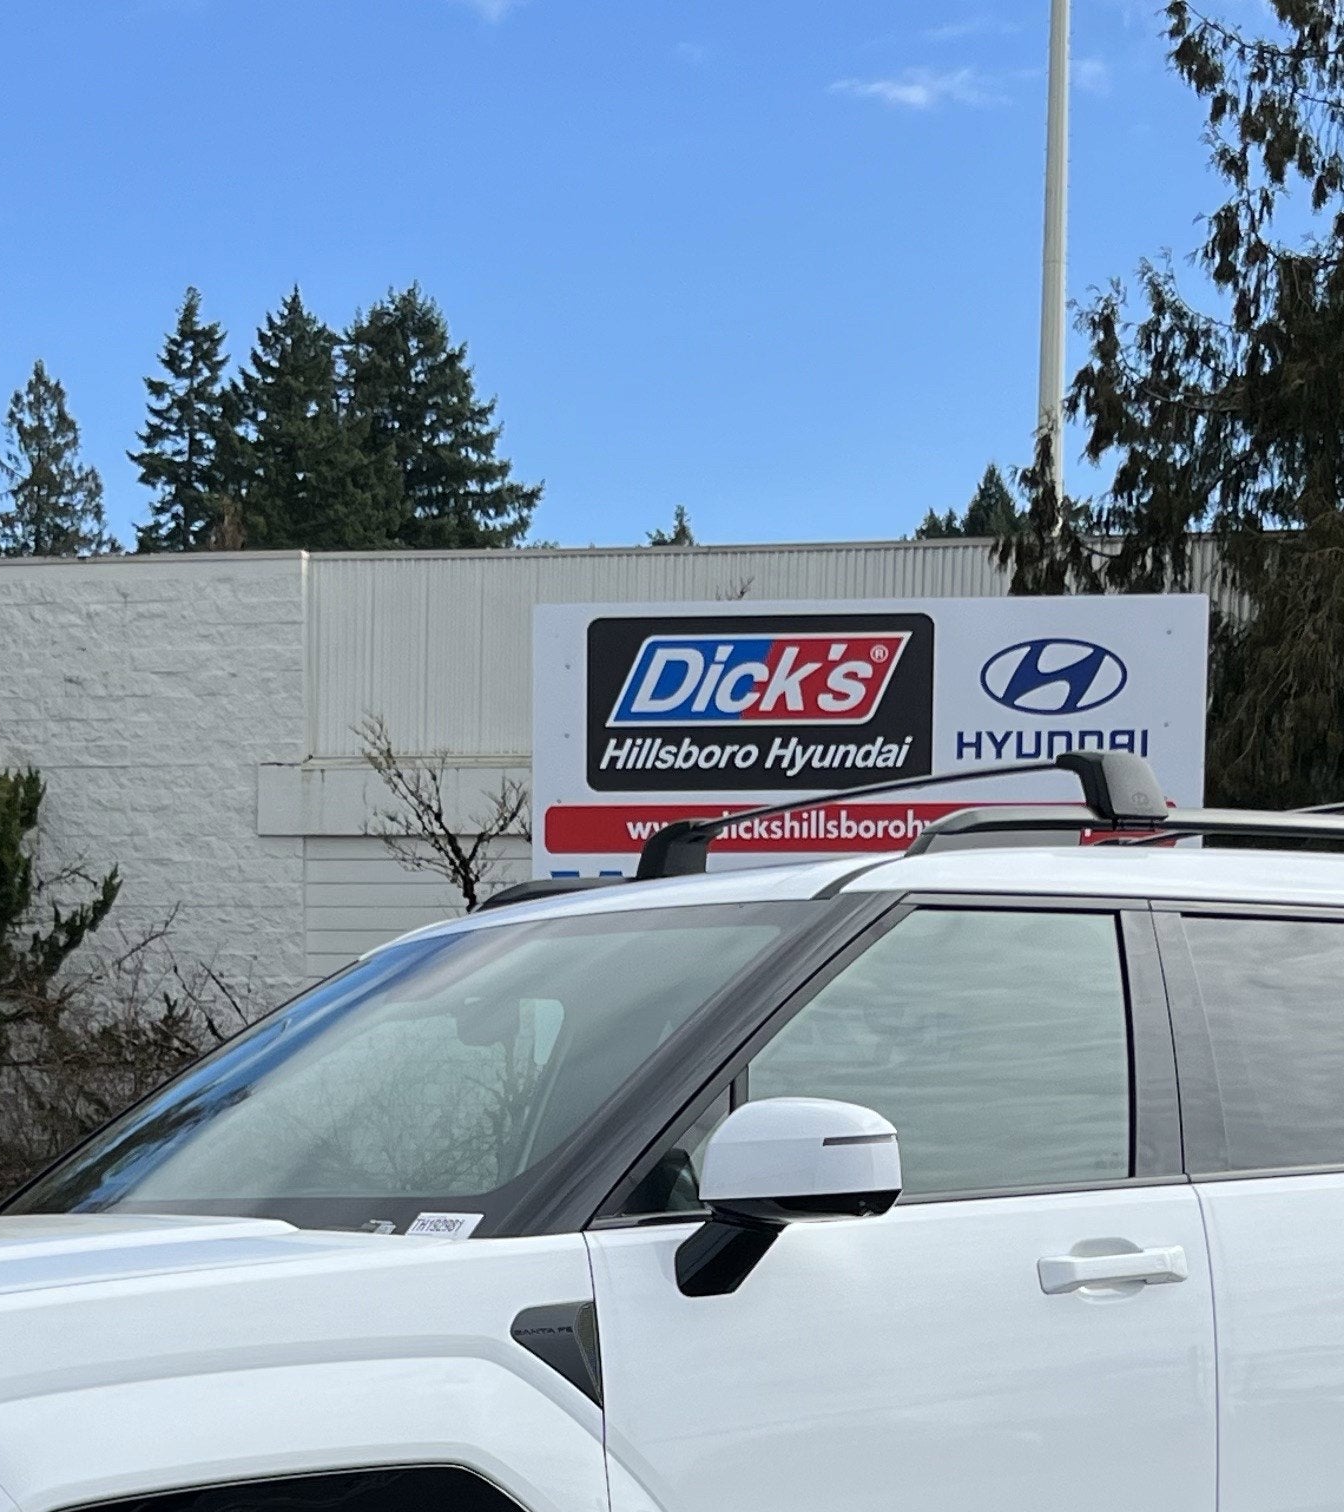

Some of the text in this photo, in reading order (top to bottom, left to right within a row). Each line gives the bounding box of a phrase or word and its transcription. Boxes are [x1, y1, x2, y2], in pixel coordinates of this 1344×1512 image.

[630, 643, 873, 713] Dick's
[599, 735, 914, 777] Hillsboro Hyundai
[955, 729, 1149, 759] HYUNDAI
[514, 1327, 555, 1336] SANTA
